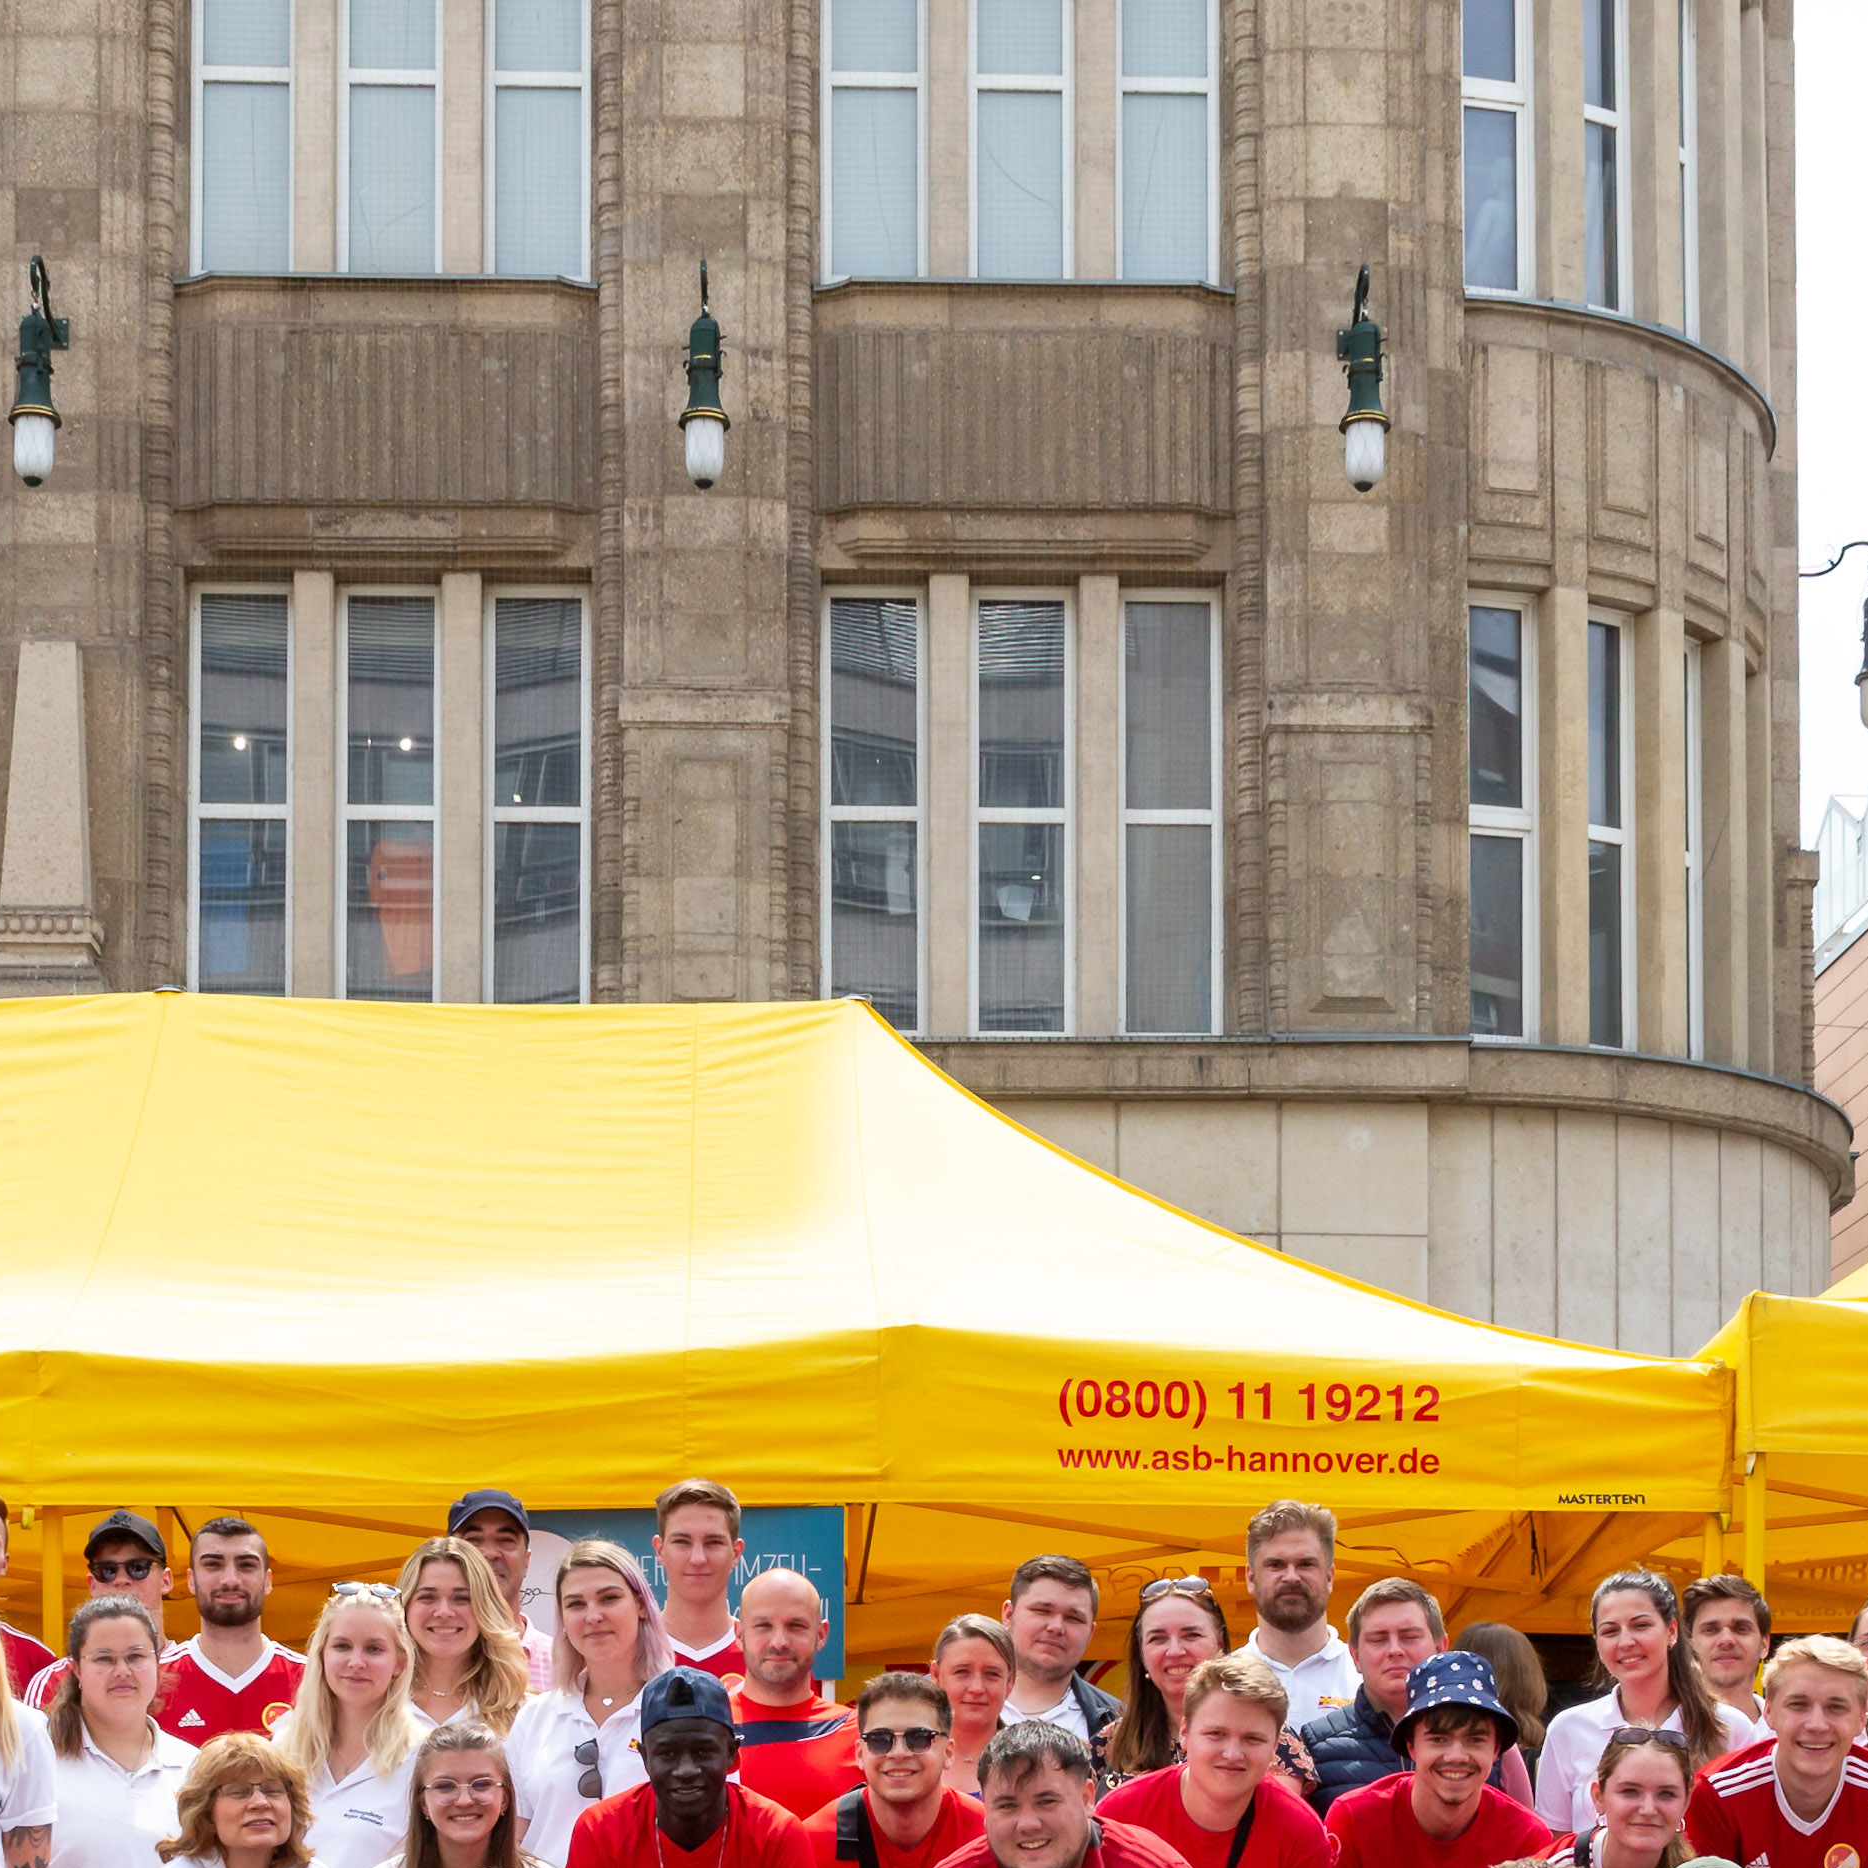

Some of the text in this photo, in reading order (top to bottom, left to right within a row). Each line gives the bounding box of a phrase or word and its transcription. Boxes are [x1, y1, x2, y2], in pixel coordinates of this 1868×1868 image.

[1058, 1378, 1441, 1429] (0800) 11 19212
[1057, 1443, 1441, 1476] www.asb-hannover.de
[1557, 1493, 1645, 1506] MASTERTENT
